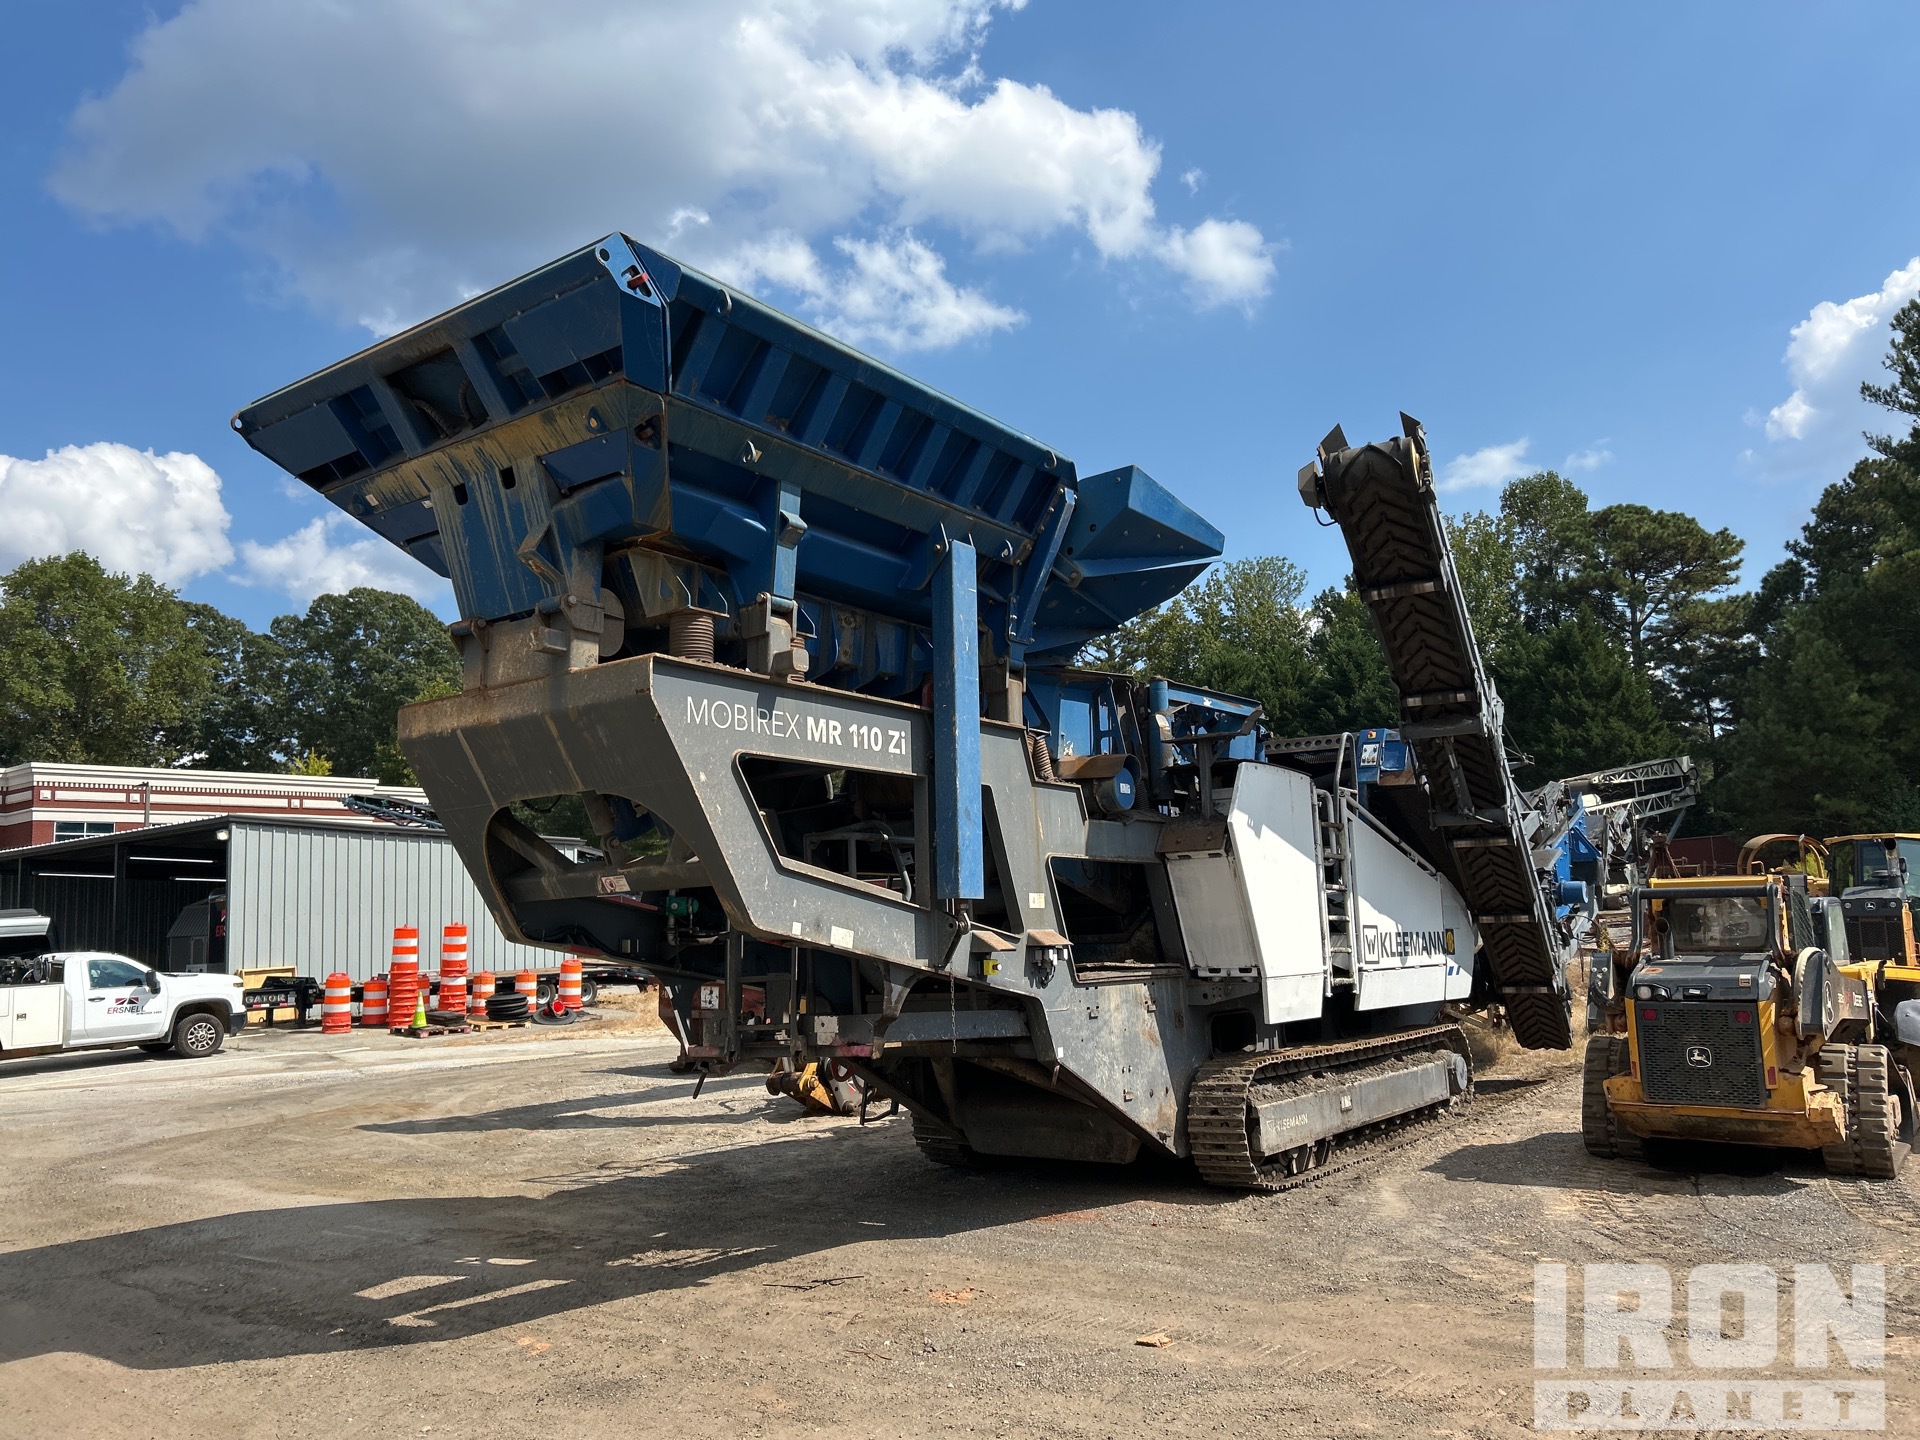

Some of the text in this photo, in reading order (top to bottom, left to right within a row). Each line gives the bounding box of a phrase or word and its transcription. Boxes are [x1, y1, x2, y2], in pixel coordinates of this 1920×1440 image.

[686, 696, 906, 755] MOBIREX MR 110 Zi
[1380, 930, 1447, 958] KLEEMANN
[245, 993, 286, 1004] GATOR
[107, 1006, 146, 1014] ERSNELL
